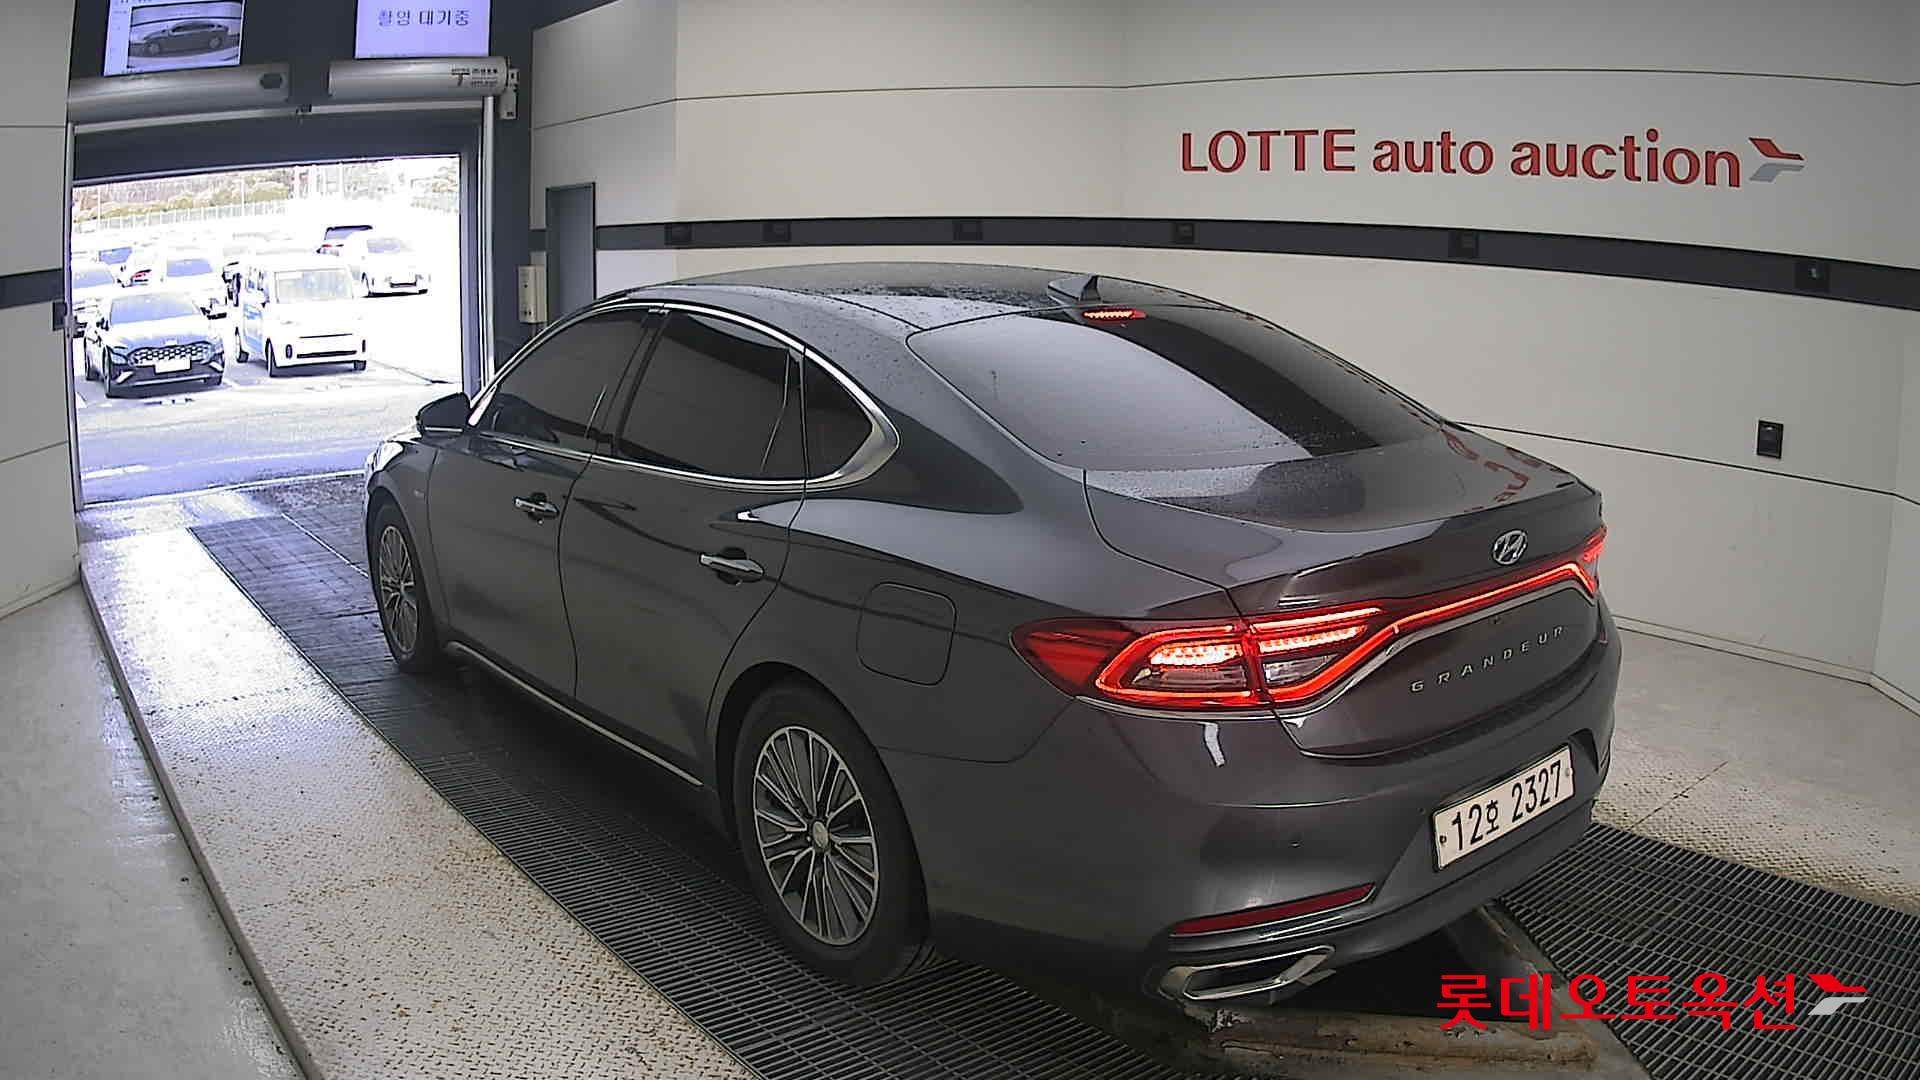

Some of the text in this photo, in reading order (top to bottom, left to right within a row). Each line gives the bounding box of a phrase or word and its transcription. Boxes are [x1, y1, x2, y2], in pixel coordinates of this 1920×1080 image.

[418, 9, 470, 27] 대기중
[1181, 128, 1742, 188] LOTTE auto auction
[1411, 626, 1563, 692] GRANDEUR
[1452, 760, 1561, 850] 12호 2327
